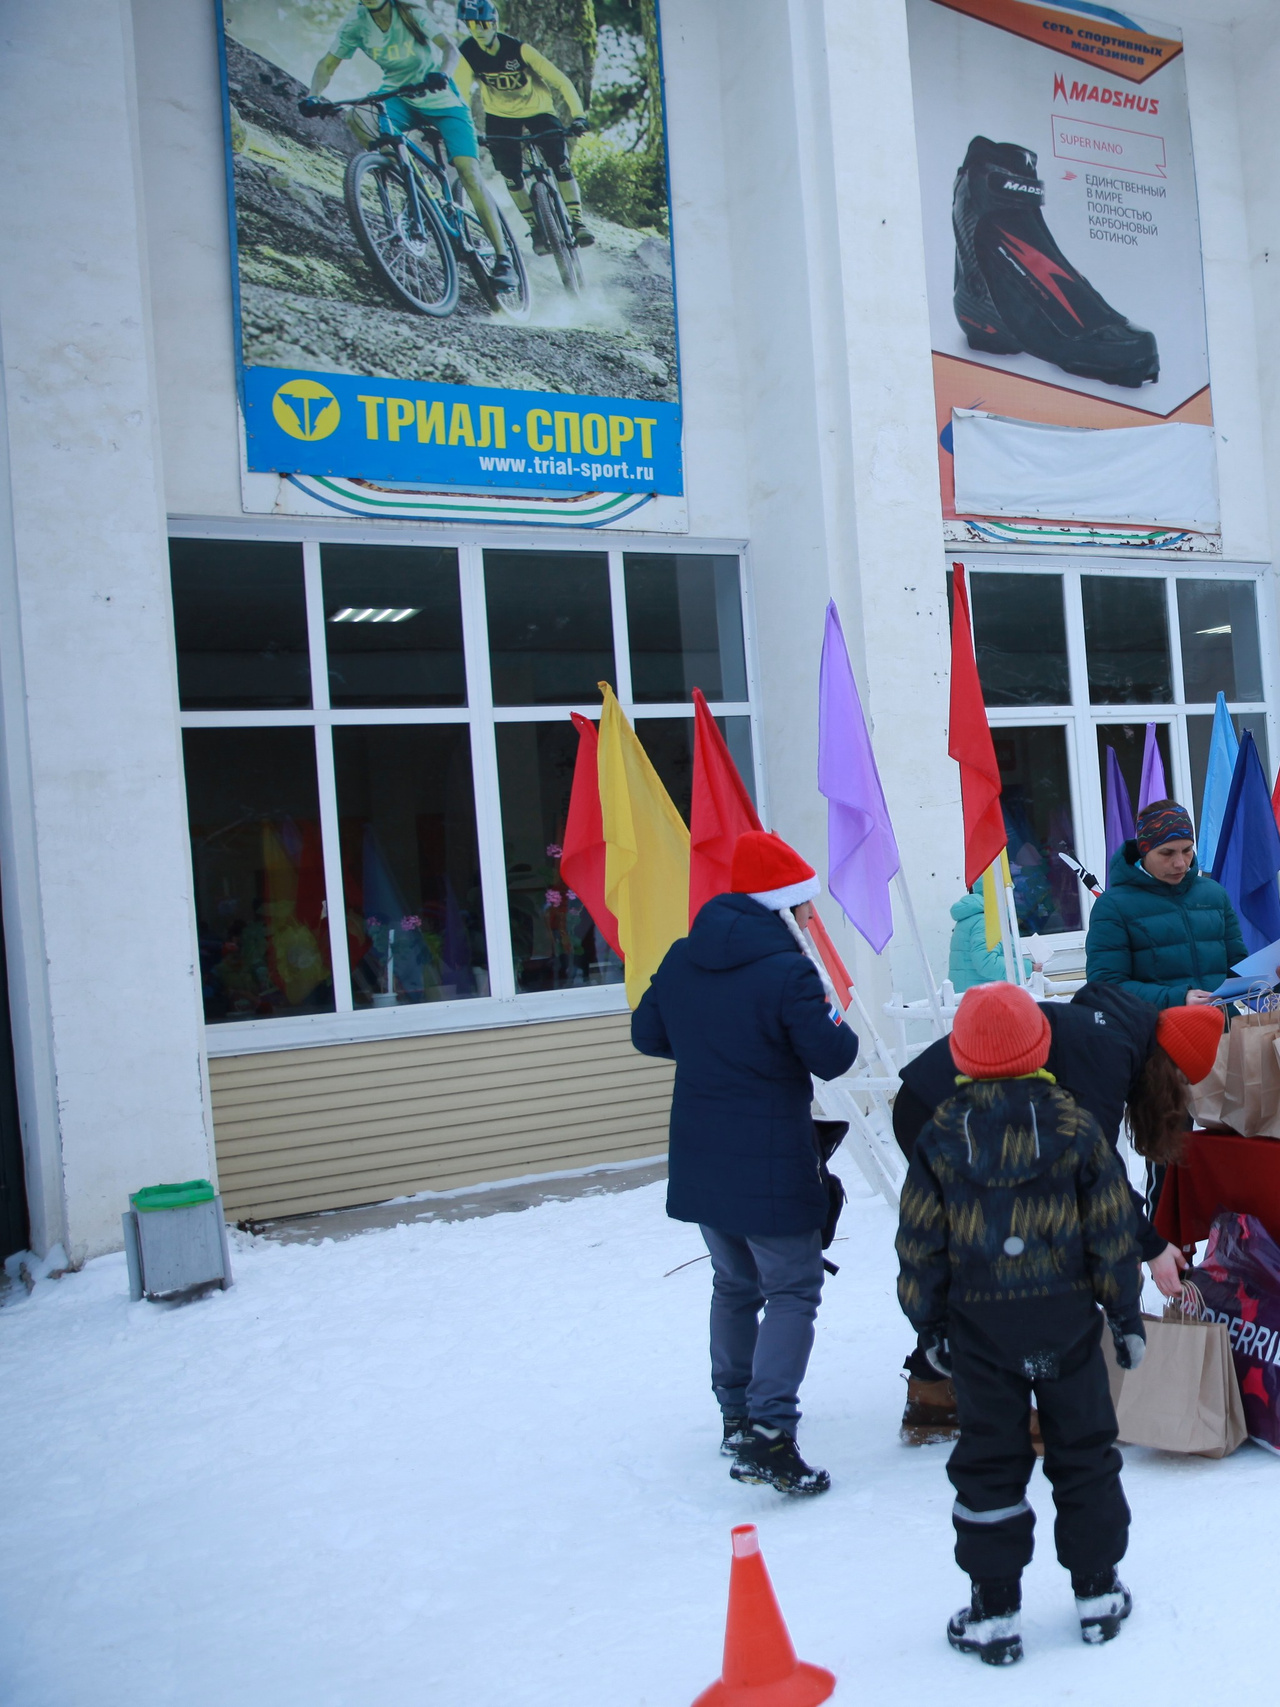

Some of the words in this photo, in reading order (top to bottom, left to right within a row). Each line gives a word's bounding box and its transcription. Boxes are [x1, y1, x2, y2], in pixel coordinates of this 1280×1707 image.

[1042, 21, 1074, 35] сеть
[1077, 29, 1163, 57] спортивных
[372, 41, 417, 60] FOX
[1071, 40, 1145, 65] магазинов
[485, 74, 522, 91] FOX
[1069, 81, 1159, 115] MADSHUS
[1060, 133, 1092, 148] SUPER
[1093, 140, 1123, 155] NANO
[1085, 174, 1167, 198] ЕДИНСТВЕННЫЙ
[1086, 188, 1093, 198] В
[1095, 190, 1123, 204] МИРЕ
[1087, 201, 1152, 222] ПОЛНОСТЬЮ
[1088, 214, 1158, 236] КАРБОНОВЫЙ
[1089, 228, 1138, 246] БОТИНОК
[479, 456, 654, 481] www.trial-sport.ru
